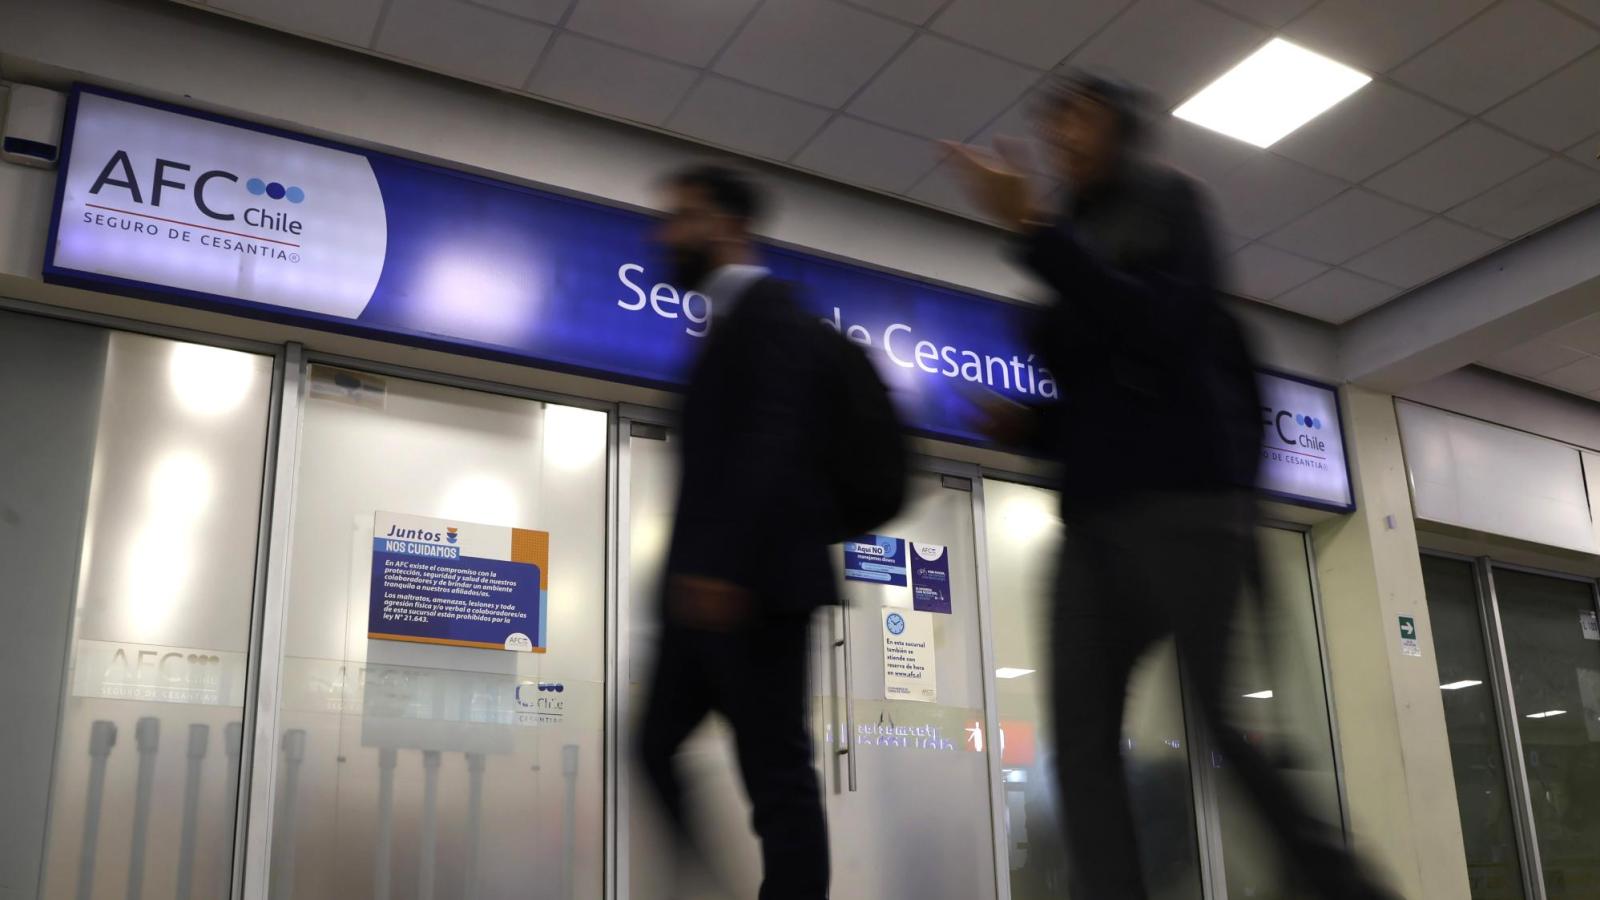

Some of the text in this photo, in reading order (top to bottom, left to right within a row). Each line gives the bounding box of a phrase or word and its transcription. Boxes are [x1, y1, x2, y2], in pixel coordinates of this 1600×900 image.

[88, 149, 239, 221] AFC
[83, 211, 159, 236] SEGURO
[168, 228, 191, 242] DE
[243, 207, 303, 236] Chile
[616, 262, 713, 338] Seg
[883, 322, 1059, 400] Cesantía
[1298, 434, 1325, 452] Chile
[387, 524, 442, 542] Juntos
[386, 540, 457, 559] NOS CUIDAMOS
[871, 547, 883, 555] NO
[395, 560, 409, 568] AFC
[409, 563, 429, 571] existe
[437, 566, 477, 577] compromiso
[490, 570, 497, 578] la
[384, 573, 433, 584] colaboradores
[482, 585, 513, 593] ambiente
[424, 570, 457, 581] seguridad
[462, 574, 480, 582] salud
[480, 576, 489, 584] de
[489, 579, 517, 587] nuestros
[383, 613, 394, 621] ley
[384, 599, 414, 608] agresión
[444, 605, 466, 613] verbal
[472, 608, 527, 619] colaboradores/as
[408, 608, 436, 617] sucursal
[456, 613, 491, 622] prohibidos
[491, 616, 503, 624] por
